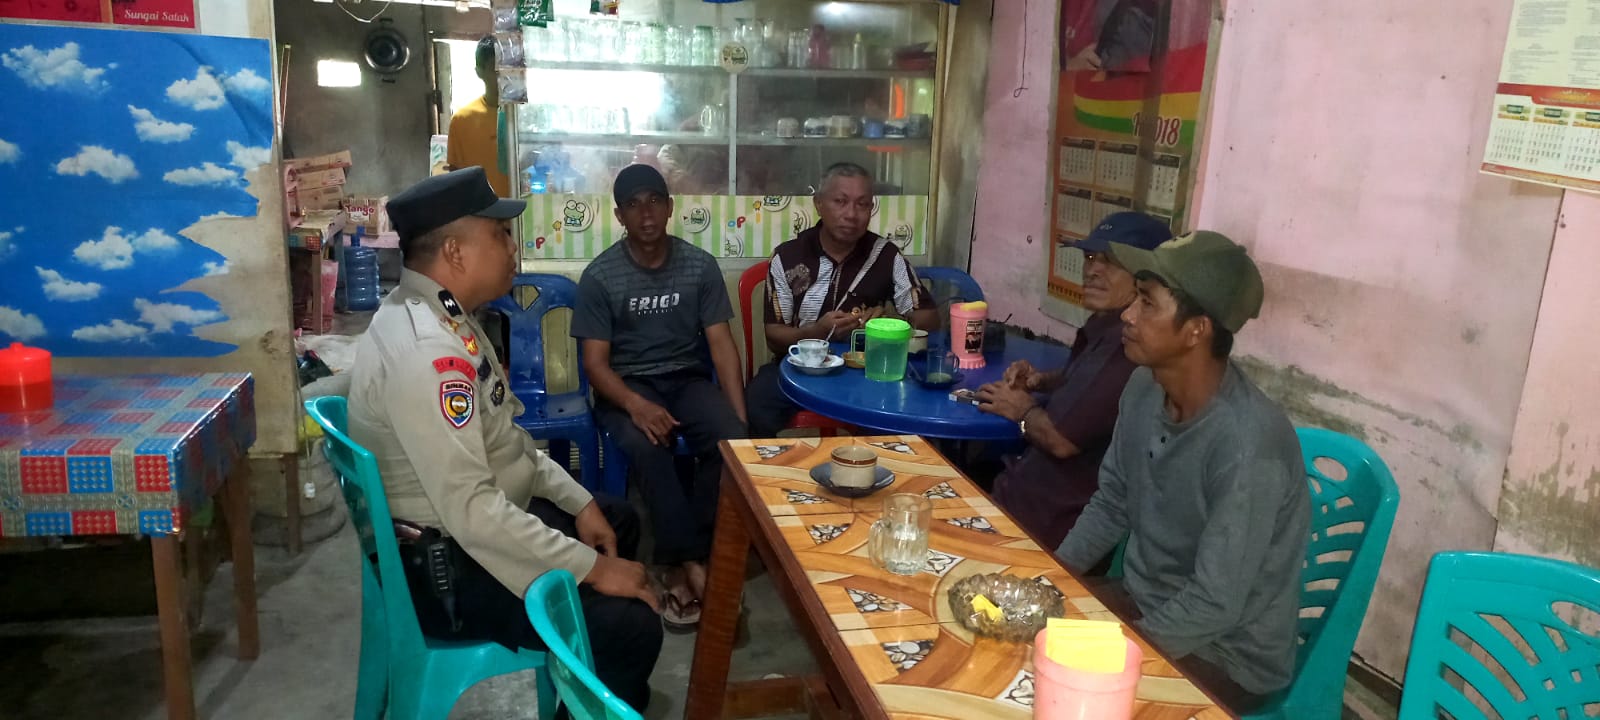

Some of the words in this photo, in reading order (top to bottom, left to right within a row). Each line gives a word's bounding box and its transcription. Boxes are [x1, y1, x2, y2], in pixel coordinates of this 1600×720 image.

[124, 9, 159, 22] Sungai
[345, 204, 375, 216] Tango
[629, 293, 680, 311] ERIGO
